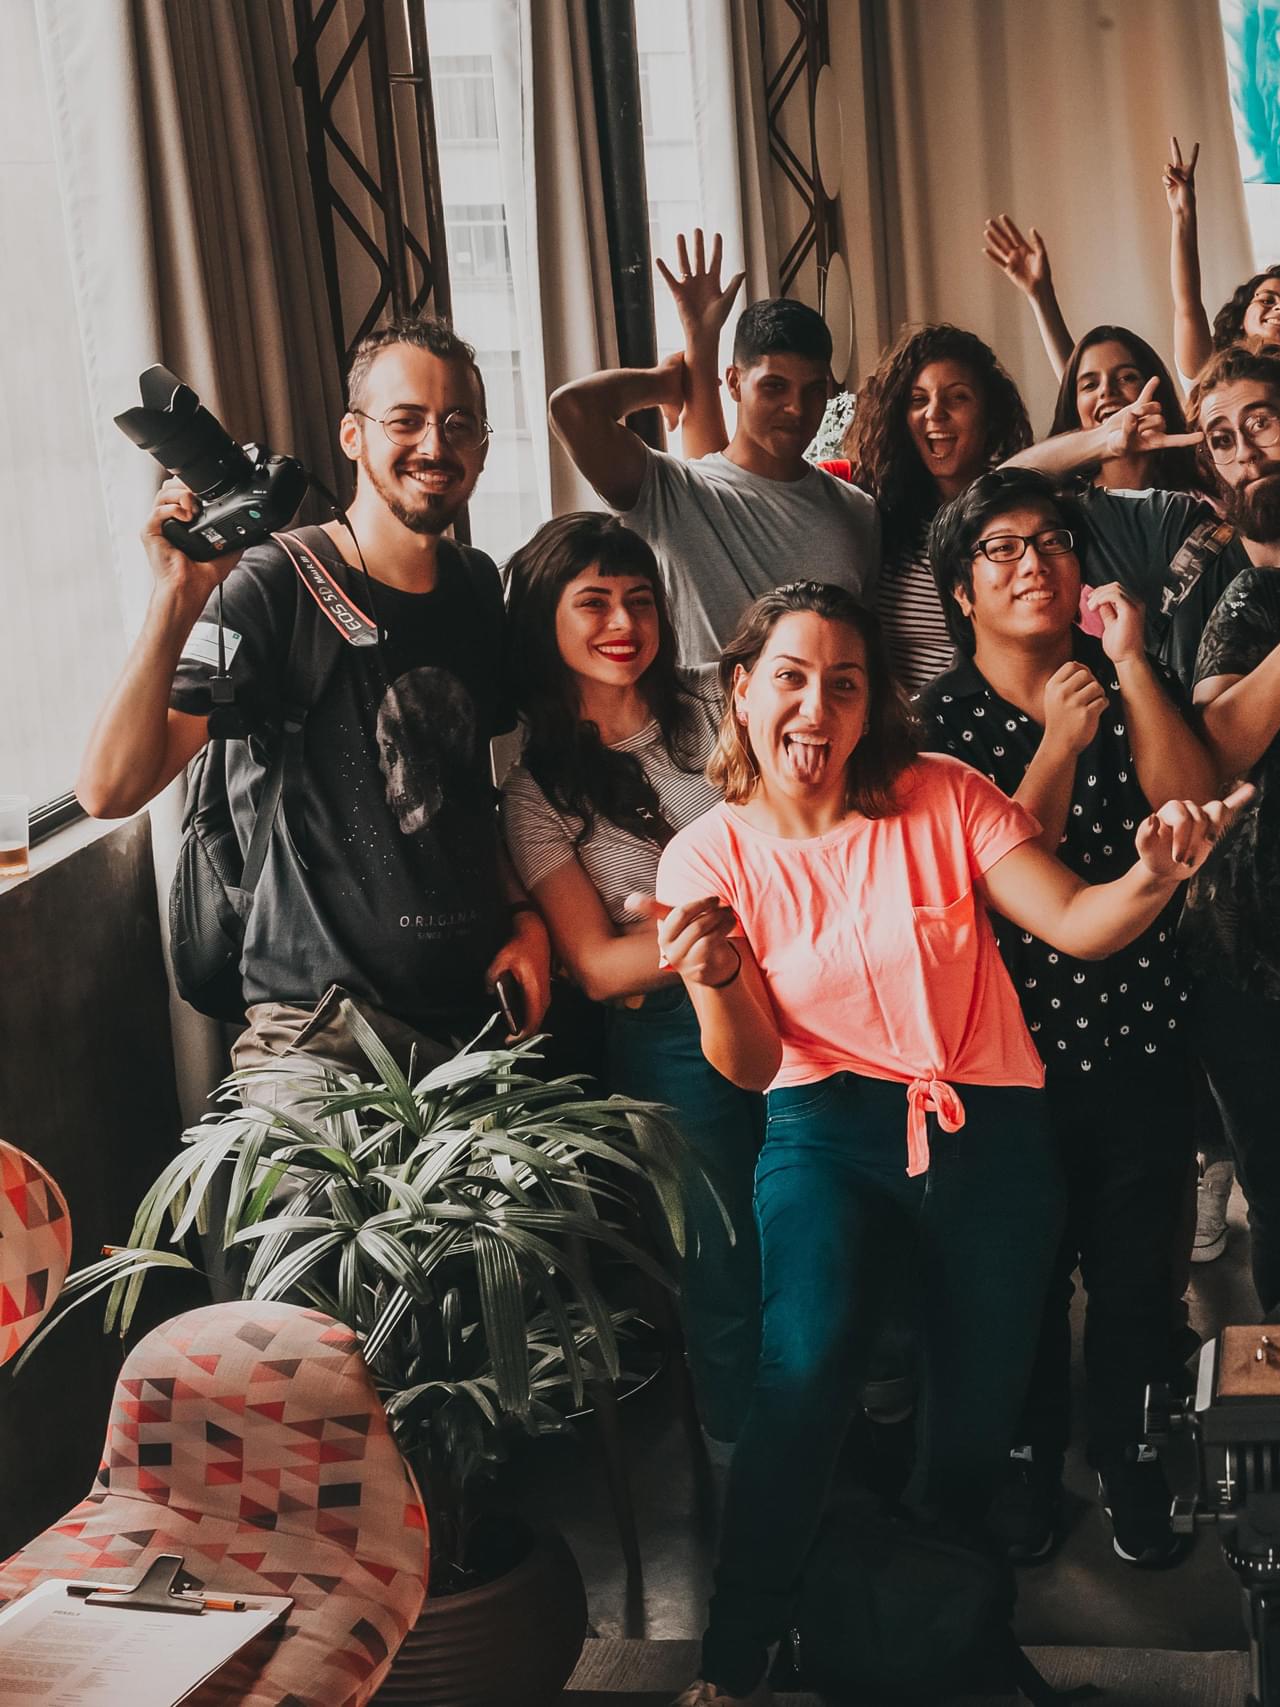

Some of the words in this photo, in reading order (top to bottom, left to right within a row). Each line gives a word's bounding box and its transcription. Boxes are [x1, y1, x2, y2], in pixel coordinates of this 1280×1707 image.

[307, 563, 326, 584] Mark
[318, 586, 338, 602] 5D
[330, 604, 362, 630] EOS
